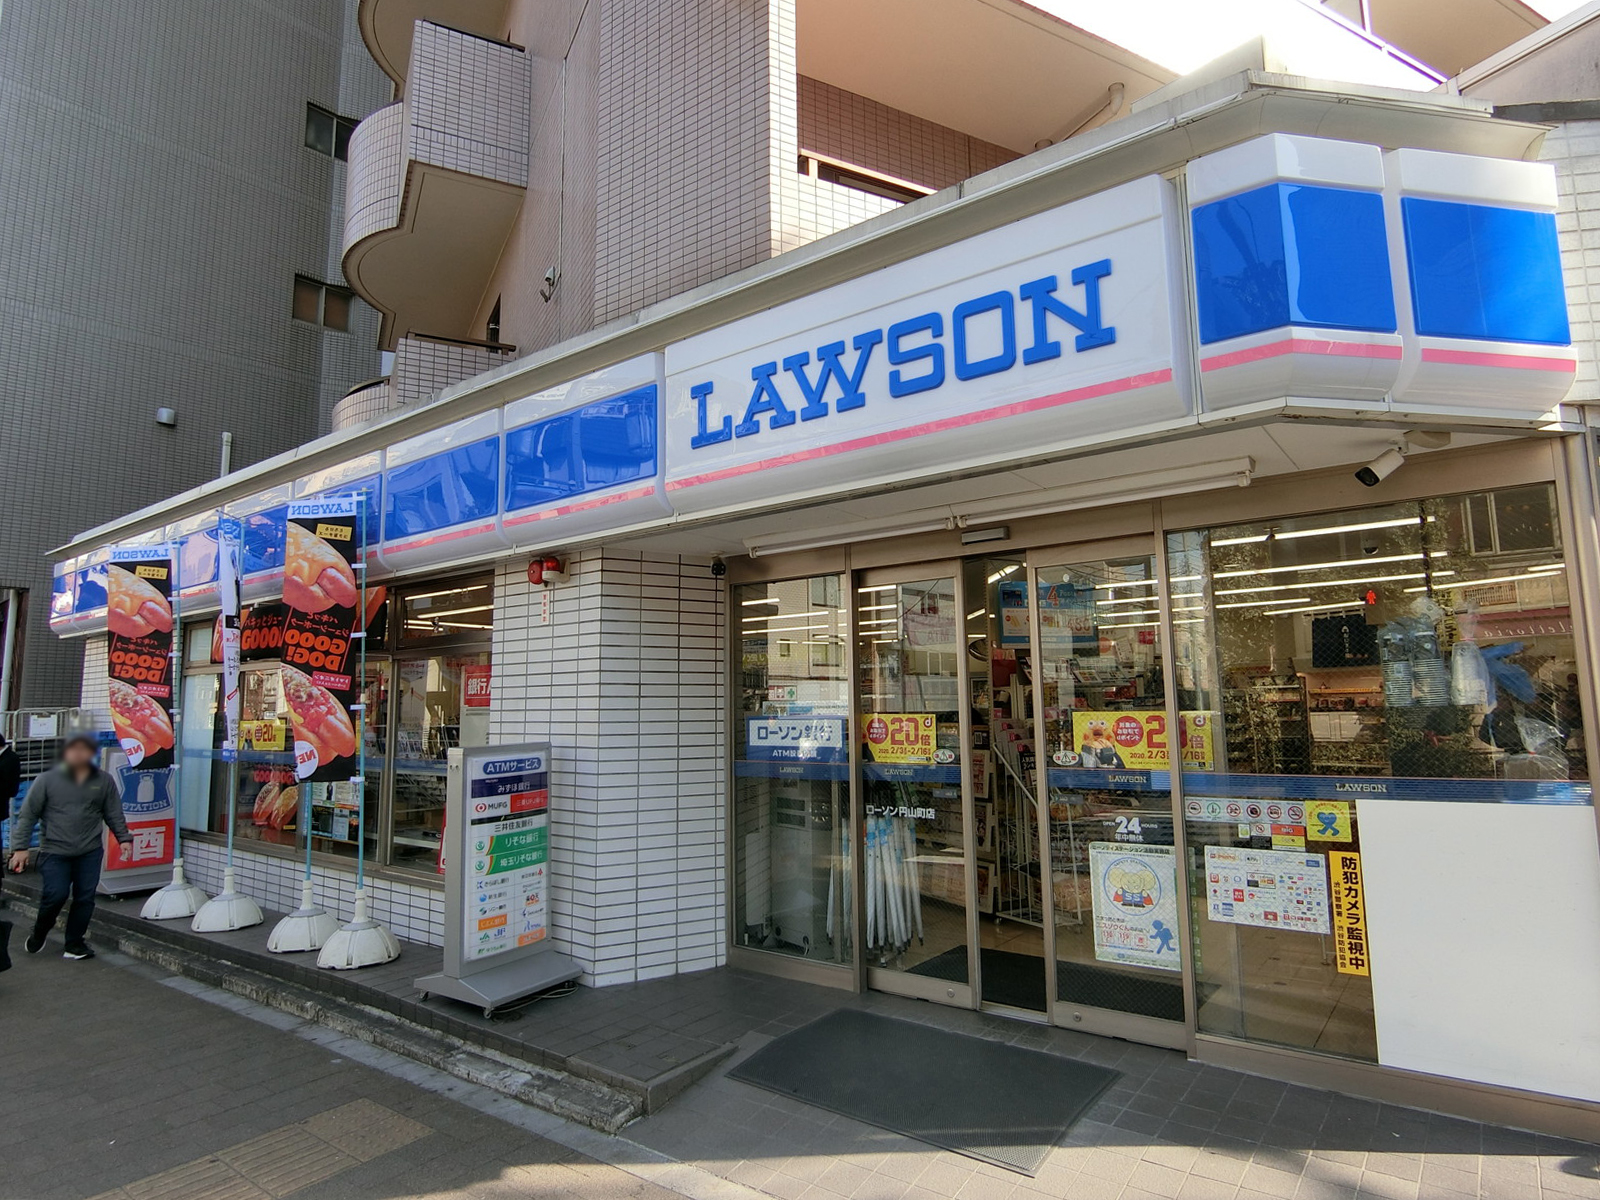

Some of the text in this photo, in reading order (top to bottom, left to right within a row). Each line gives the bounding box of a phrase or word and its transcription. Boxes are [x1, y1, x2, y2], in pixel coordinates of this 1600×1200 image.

[690, 258, 1116, 449] LAWSON
[757, 724, 833, 741] ローソン銀行
[487, 760, 539, 773] ATMサービス
[1108, 775, 1147, 783] LAWSON
[497, 782, 530, 793] みずほ銀行
[1335, 783, 1387, 793] LAWSON
[122, 799, 168, 811] STATION
[488, 801, 508, 810] MUFG
[866, 804, 936, 819] ローソン円山町店
[494, 819, 533, 832] 三井住友銀行
[1115, 815, 1142, 834] 24
[505, 833, 539, 847] りそな銀行
[1114, 833, 1145, 842] 年中無休
[499, 849, 543, 867] 埼玉りそな銀行
[1124, 892, 1141, 902] SS
[1341, 856, 1365, 970] 防犯カメラ監視中
